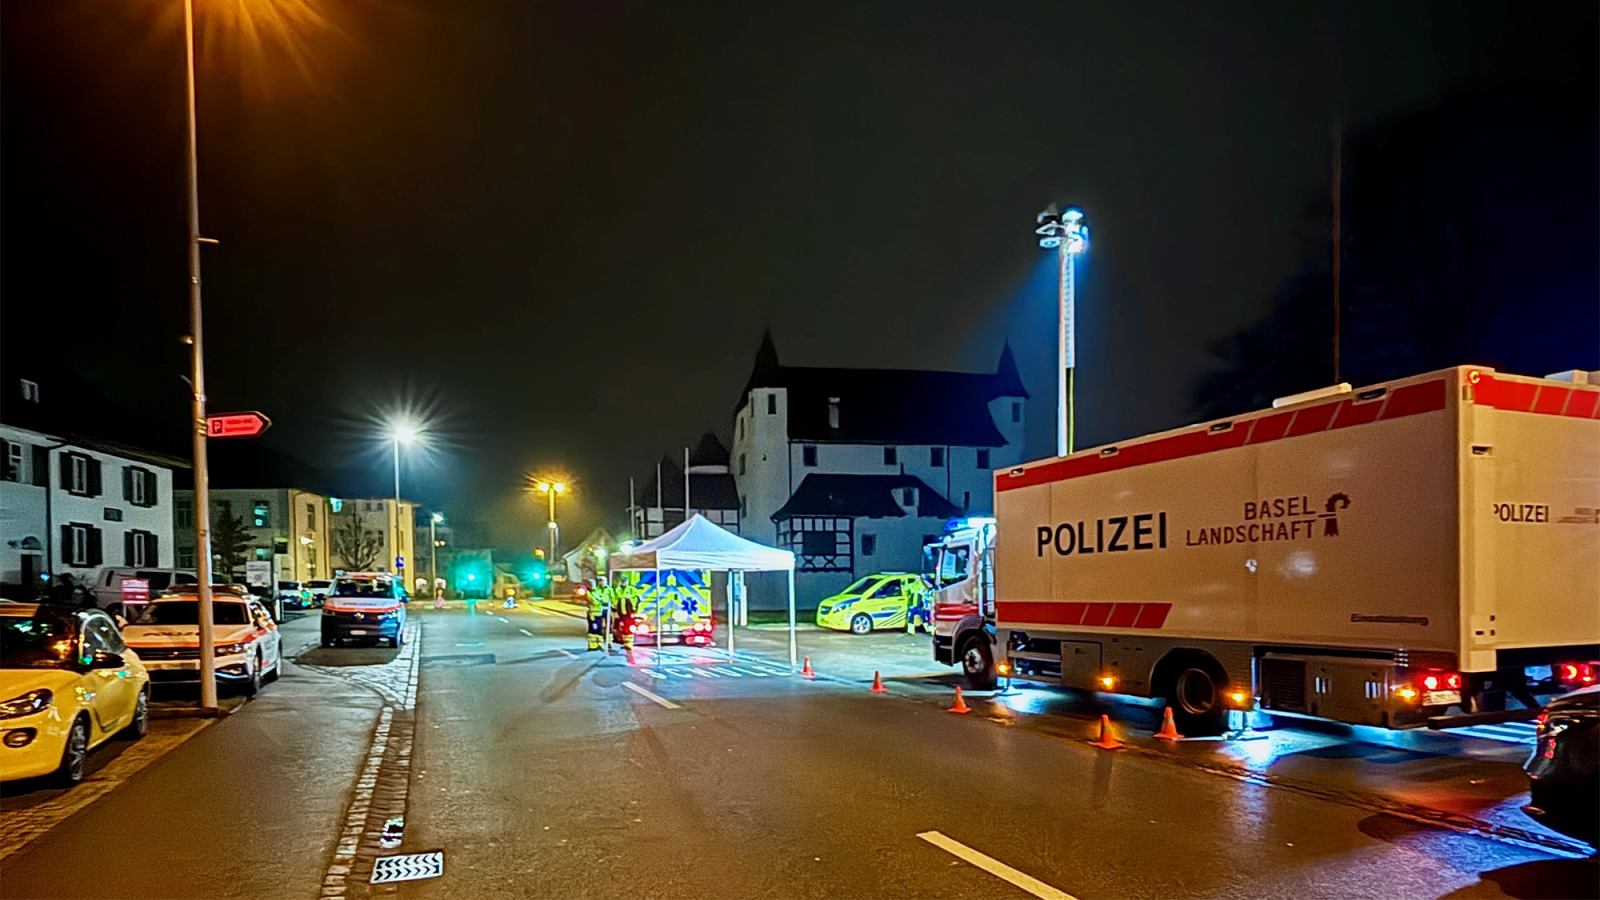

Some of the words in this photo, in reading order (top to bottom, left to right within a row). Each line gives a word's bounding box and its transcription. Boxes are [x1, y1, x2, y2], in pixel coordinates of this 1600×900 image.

[1244, 496, 1316, 520] BASEL
[1037, 512, 1167, 557] POLIZEI
[1186, 519, 1316, 546] LANDSCHAFT
[640, 666, 792, 679] SCHULE
